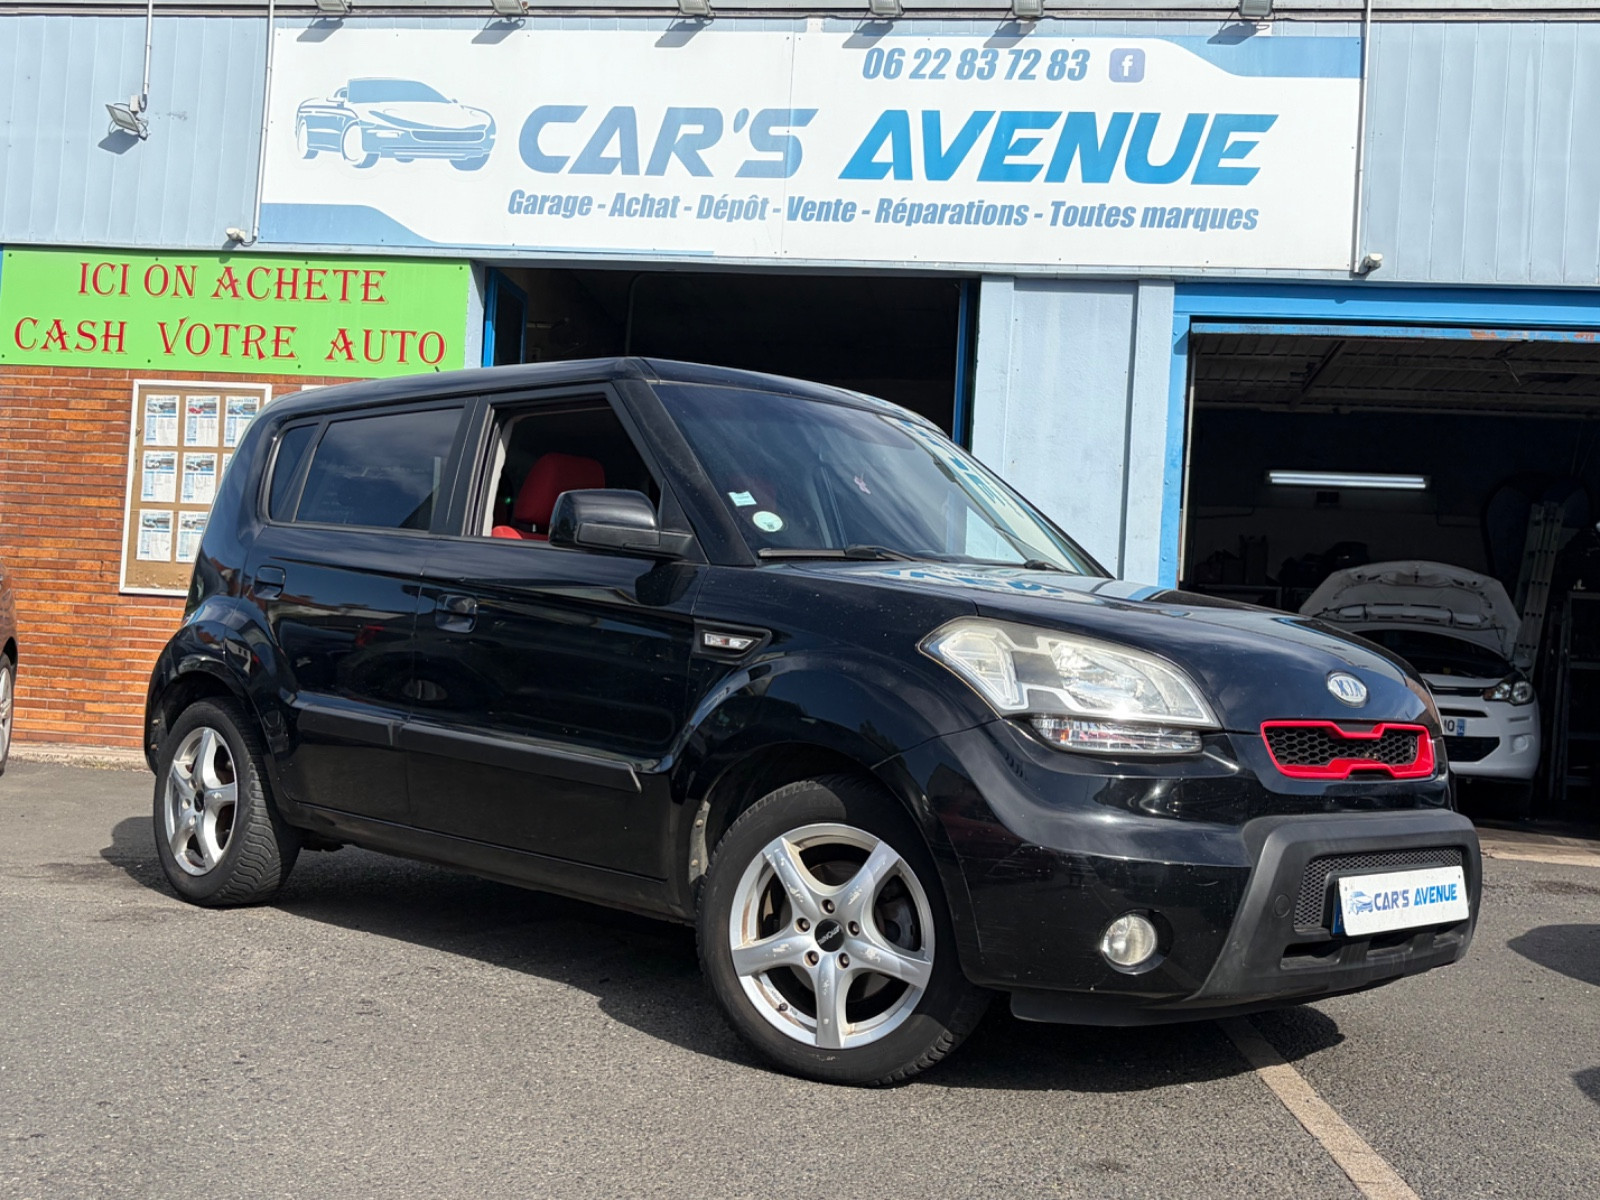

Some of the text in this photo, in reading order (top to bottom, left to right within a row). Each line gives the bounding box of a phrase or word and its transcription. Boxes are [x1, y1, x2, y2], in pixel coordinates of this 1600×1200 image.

[862, 47, 1091, 81] 06 22 83 72 83
[518, 104, 1279, 187] CAR'S AVENUE
[507, 189, 593, 219] Garage
[608, 191, 681, 219] Achat
[695, 193, 769, 223] Dépôt
[786, 195, 858, 223] Vente
[874, 197, 1029, 228] Réparations
[1049, 200, 1136, 229] Toutes
[1140, 206, 1260, 232] marques
[79, 262, 388, 303] ICI ON ACHETE
[13, 315, 447, 365] CASH VOTRE AUTO
[1374, 883, 1458, 911] CAR'S AVENUE
